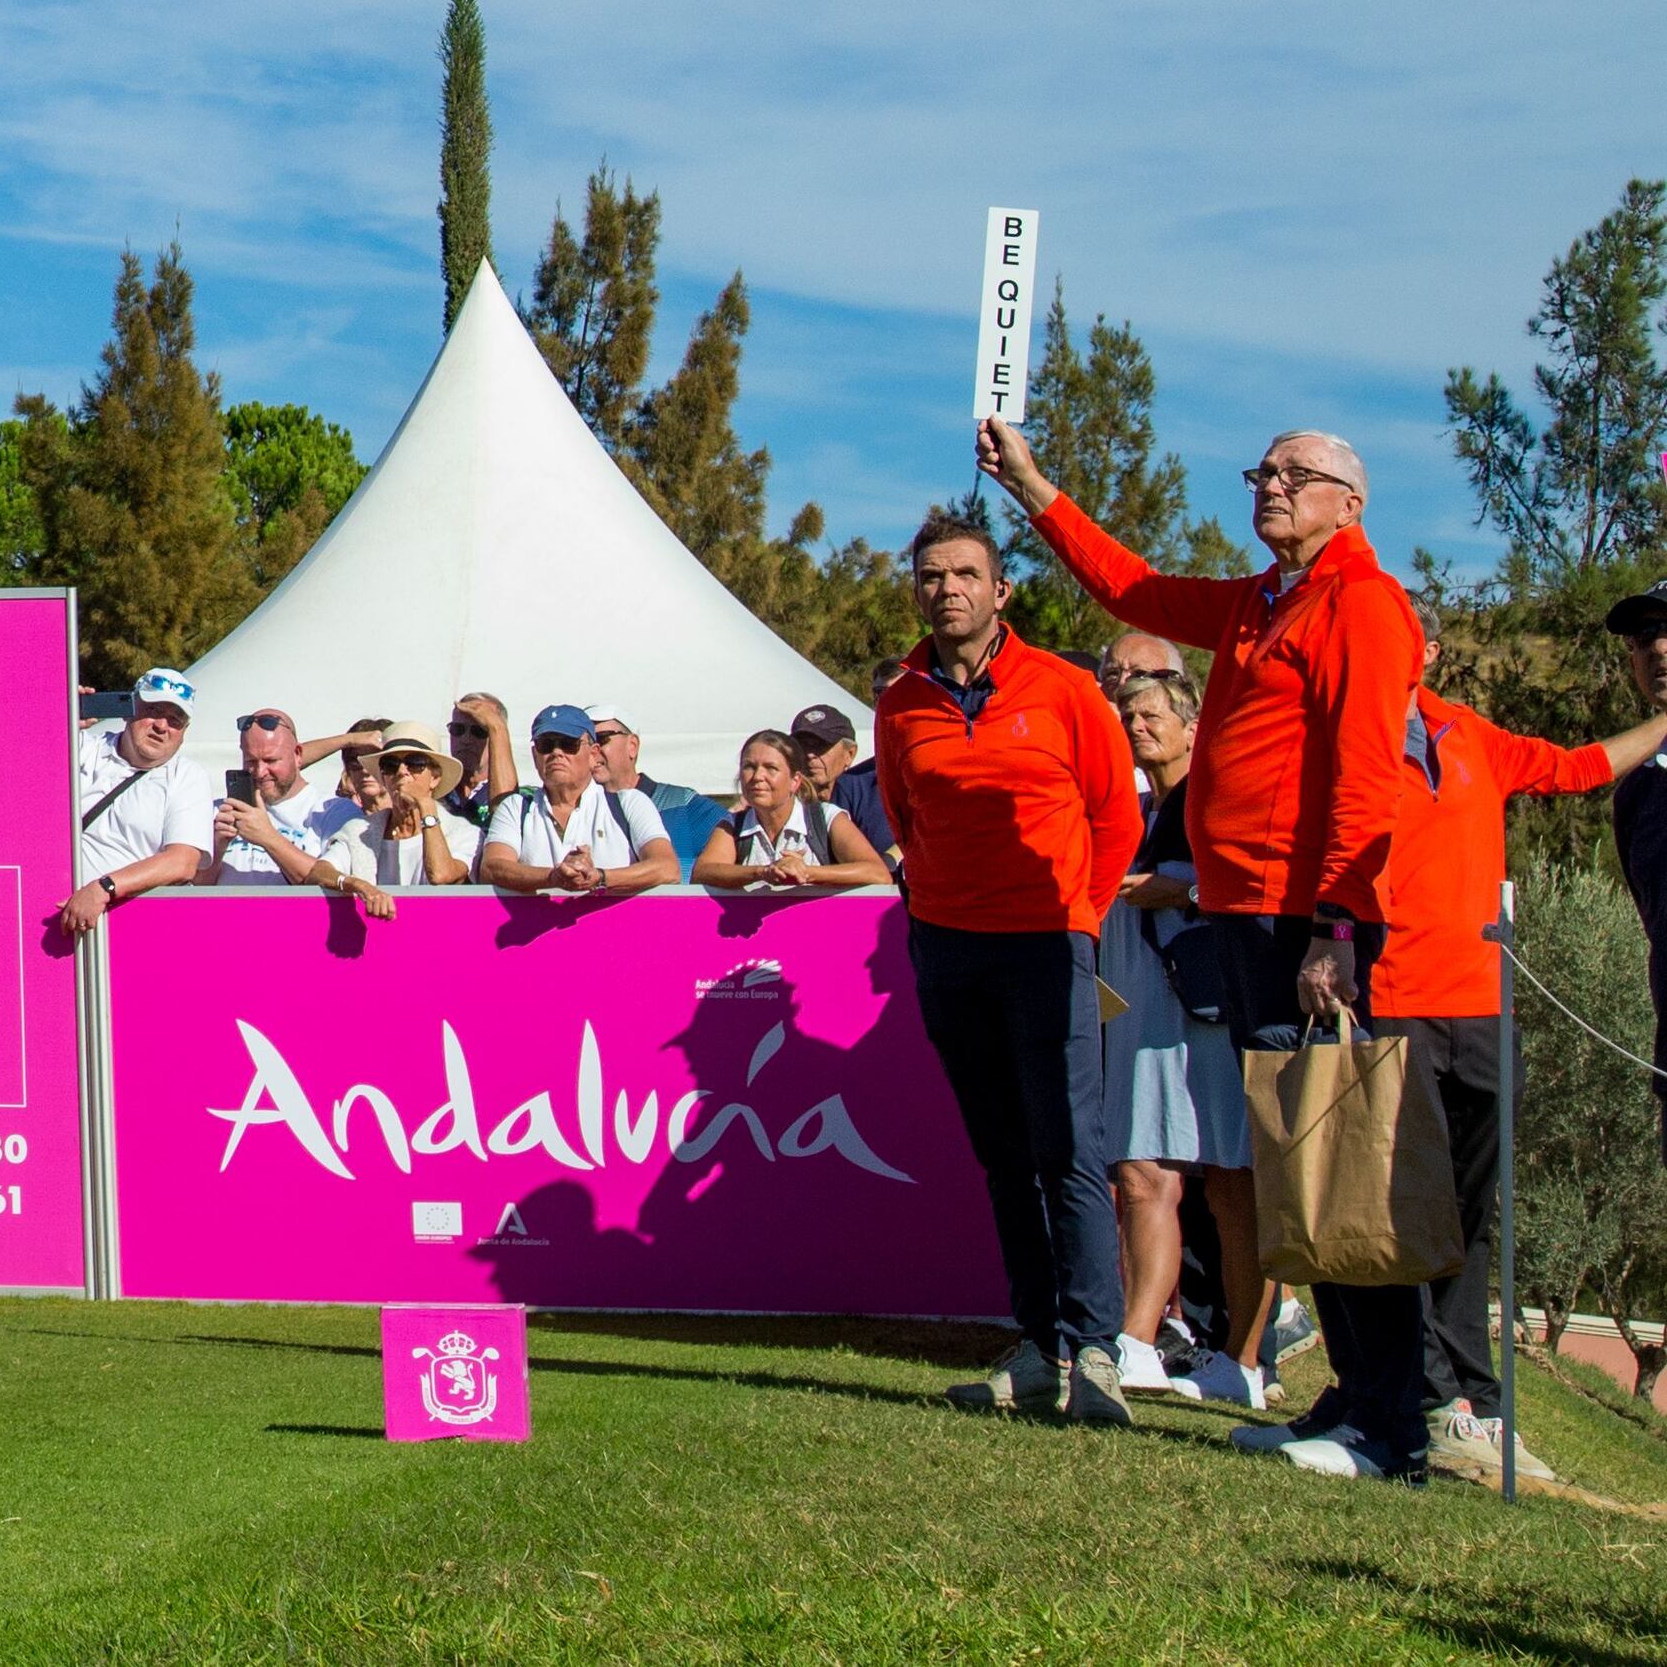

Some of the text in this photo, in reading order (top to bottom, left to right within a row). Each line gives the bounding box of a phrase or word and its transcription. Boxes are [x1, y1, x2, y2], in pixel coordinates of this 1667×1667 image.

[990, 216, 1023, 413] BE QUIET
[205, 1018, 919, 1184] Andalucía
